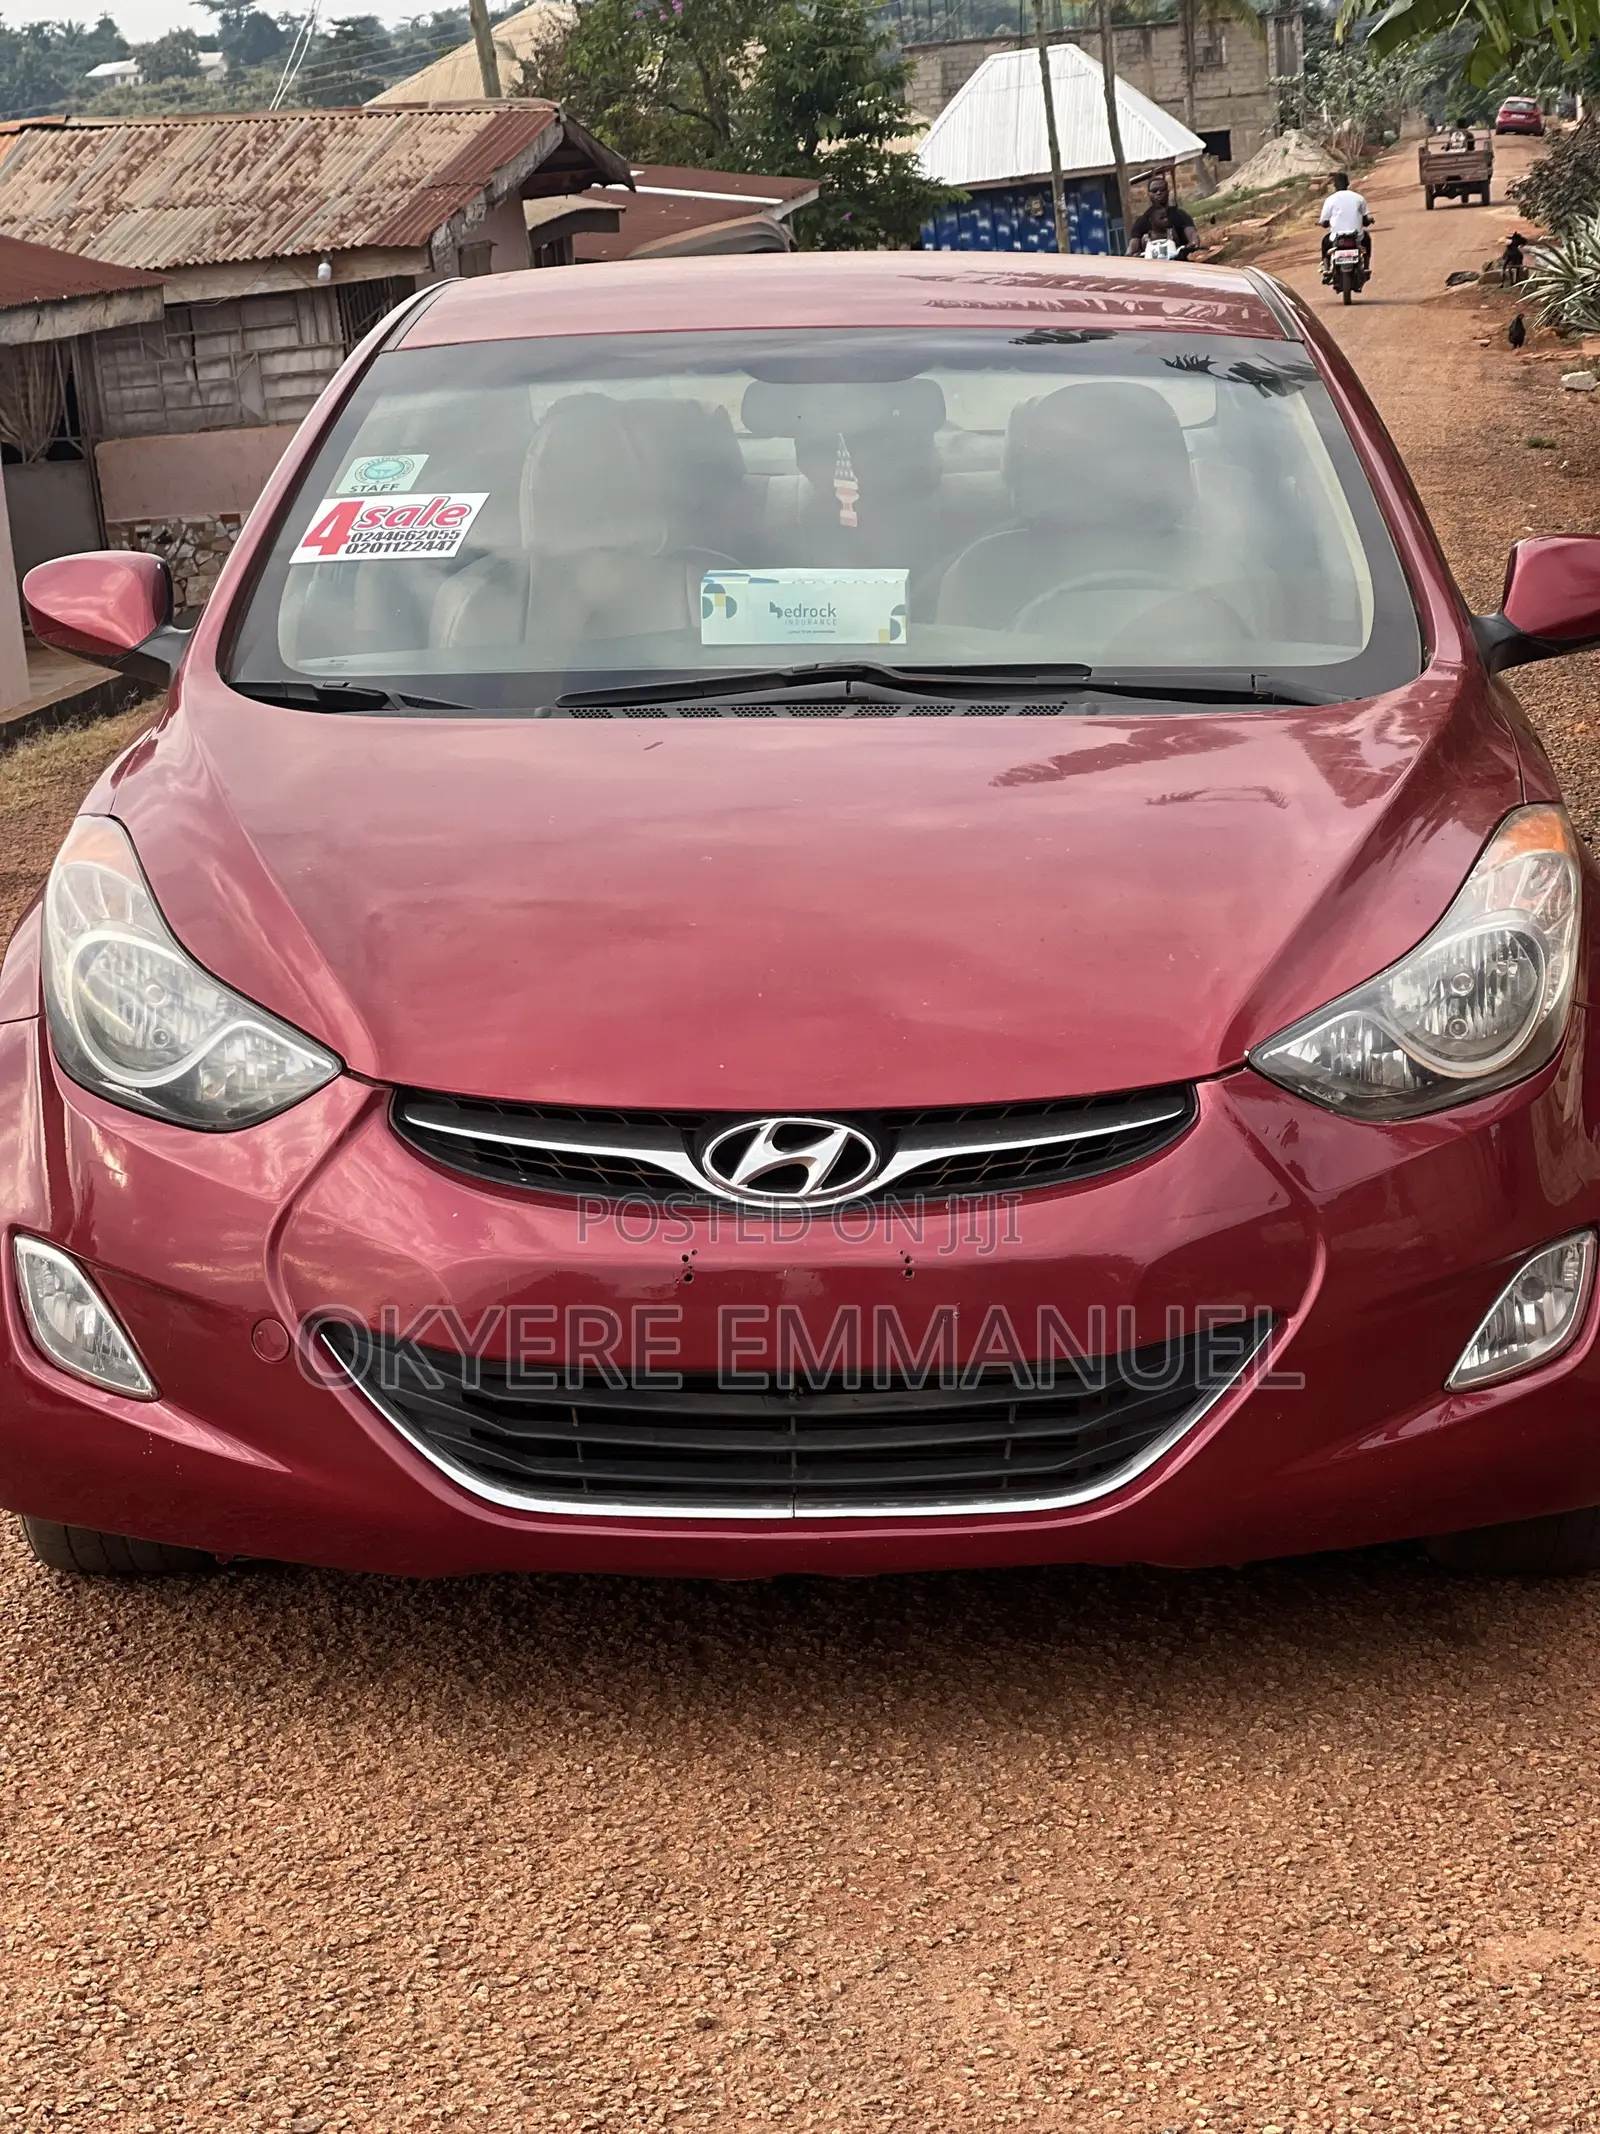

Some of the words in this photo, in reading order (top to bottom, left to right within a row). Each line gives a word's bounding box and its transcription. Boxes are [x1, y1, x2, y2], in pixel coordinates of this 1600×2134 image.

[349, 483, 400, 493] STAFF
[352, 496, 472, 531] sale
[351, 530, 461, 543] 0244662055
[345, 540, 456, 554] 0201122447
